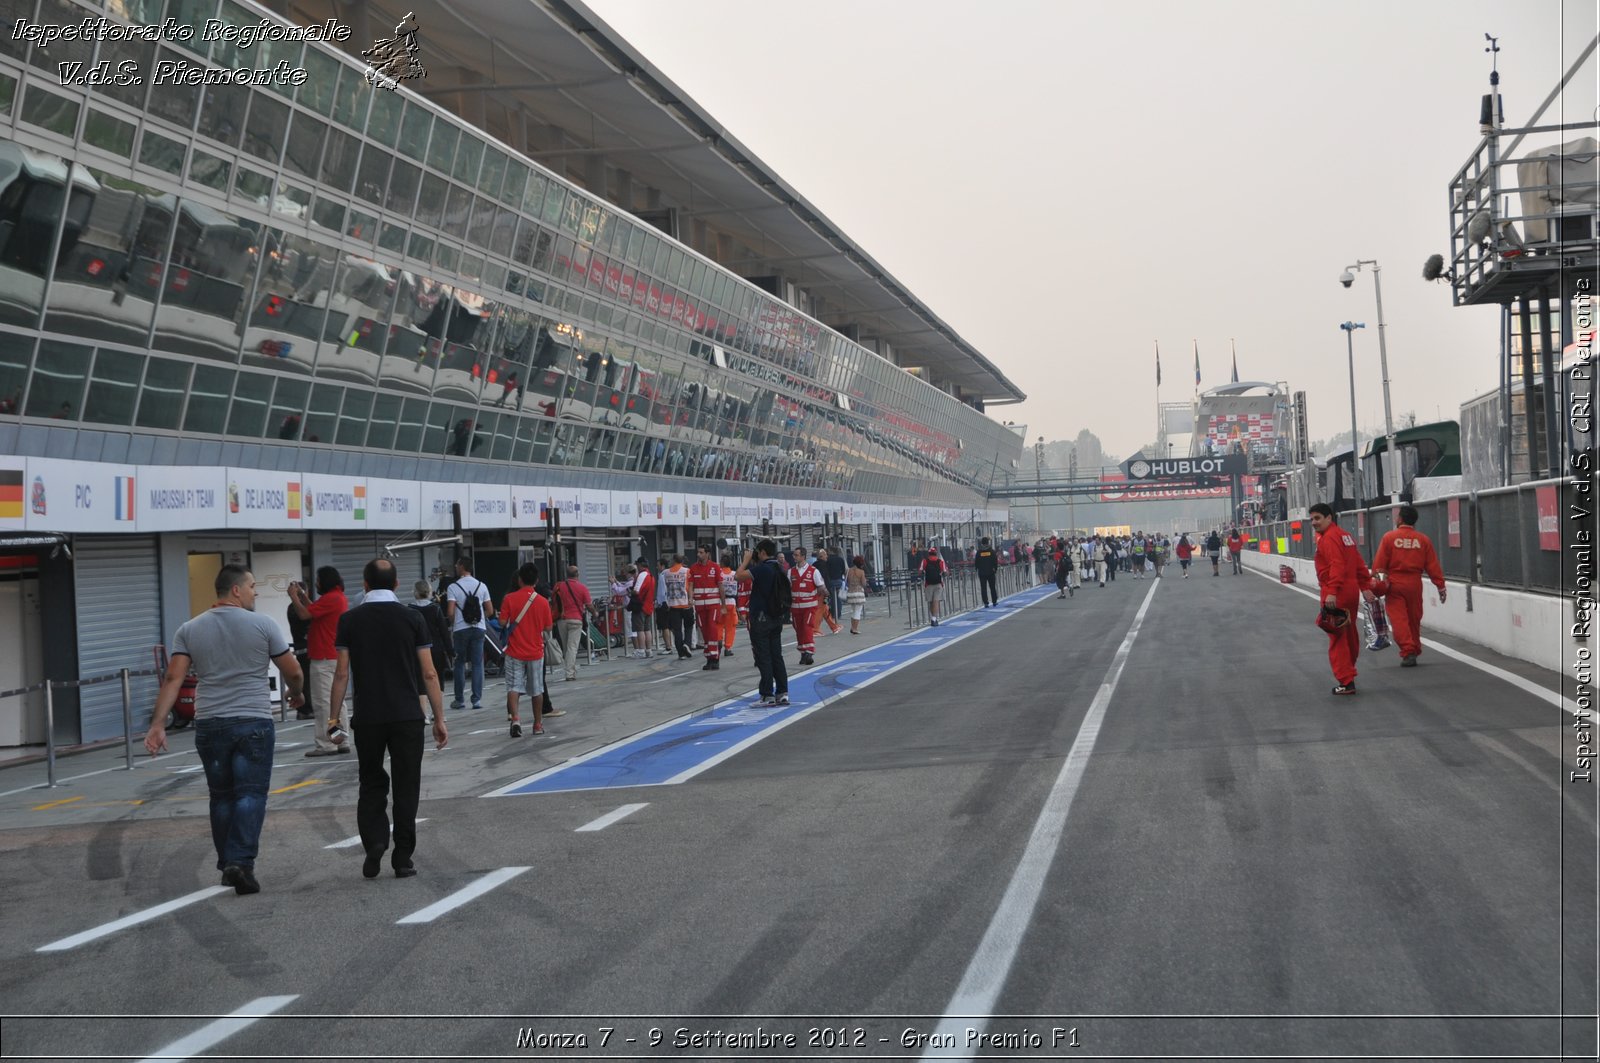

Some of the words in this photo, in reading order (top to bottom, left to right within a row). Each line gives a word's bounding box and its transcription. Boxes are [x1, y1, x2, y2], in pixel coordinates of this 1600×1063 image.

[1152, 459, 1224, 475] HUBLOT
[75, 484, 92, 509] PIC
[150, 489, 186, 509] MARUSSIA
[187, 490, 195, 509] F1
[196, 489, 215, 509] TEAM
[245, 489, 256, 509] DE
[257, 490, 265, 509] LA
[265, 490, 285, 509] ROSA
[1394, 538, 1421, 549] CEA
